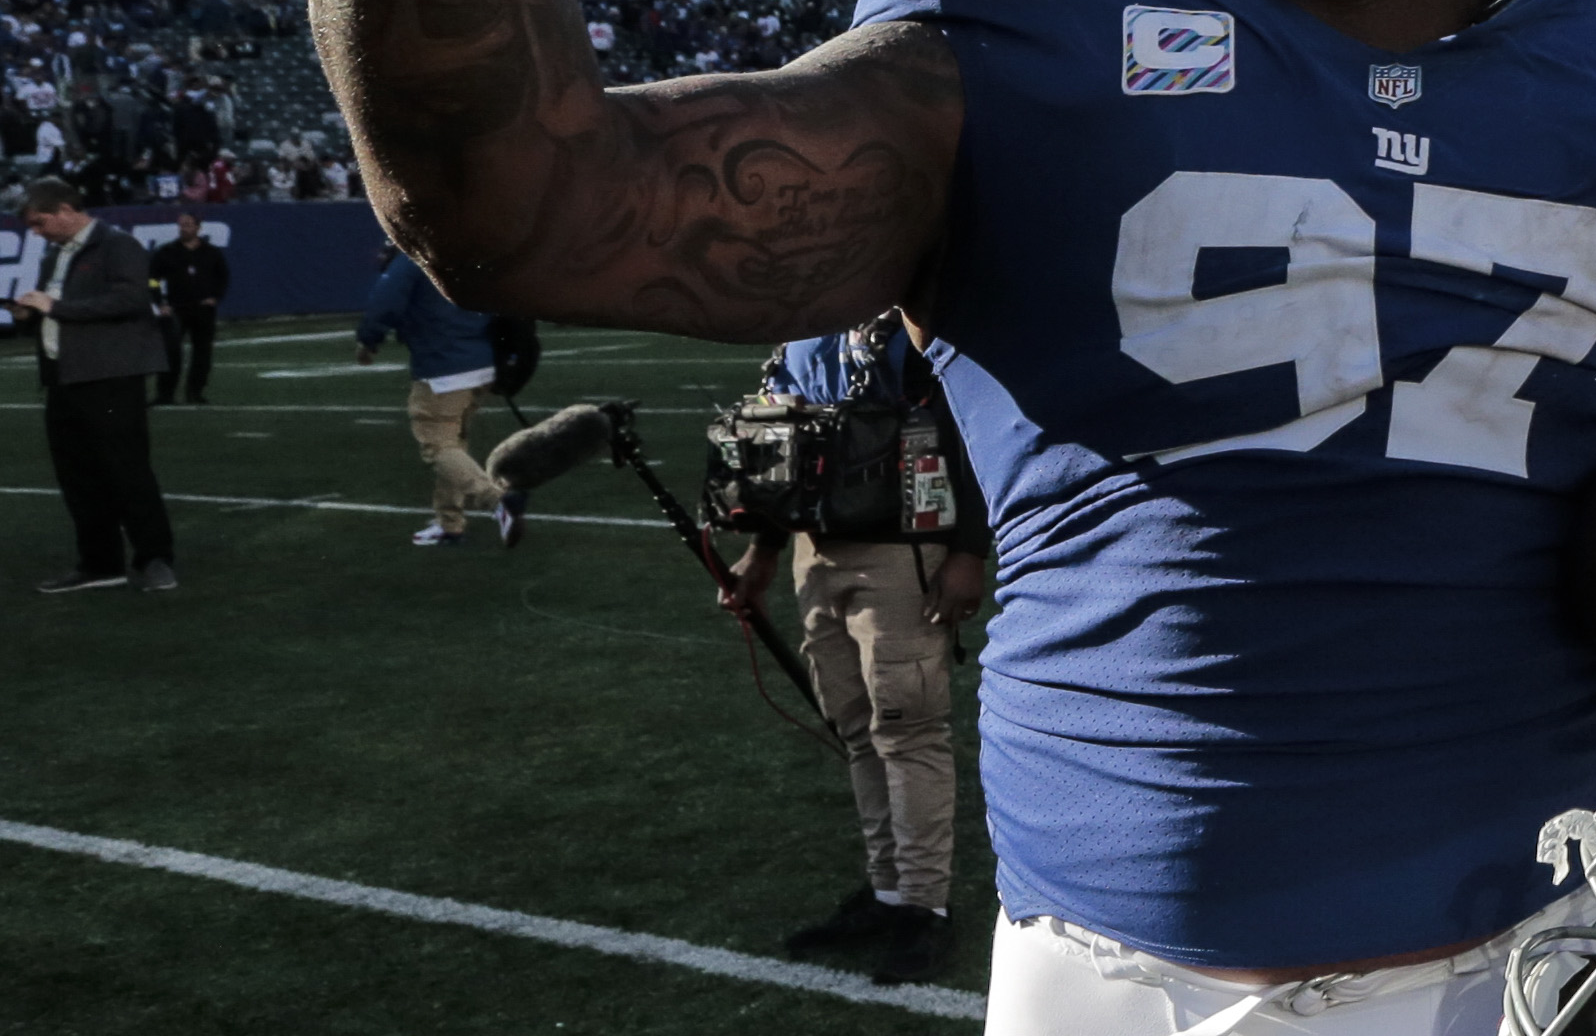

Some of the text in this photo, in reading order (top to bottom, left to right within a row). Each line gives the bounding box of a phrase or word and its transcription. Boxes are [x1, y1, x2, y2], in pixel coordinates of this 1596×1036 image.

[1133, 13, 1225, 69] C
[1376, 77, 1414, 98] NFL
[1372, 127, 1430, 176] ny
